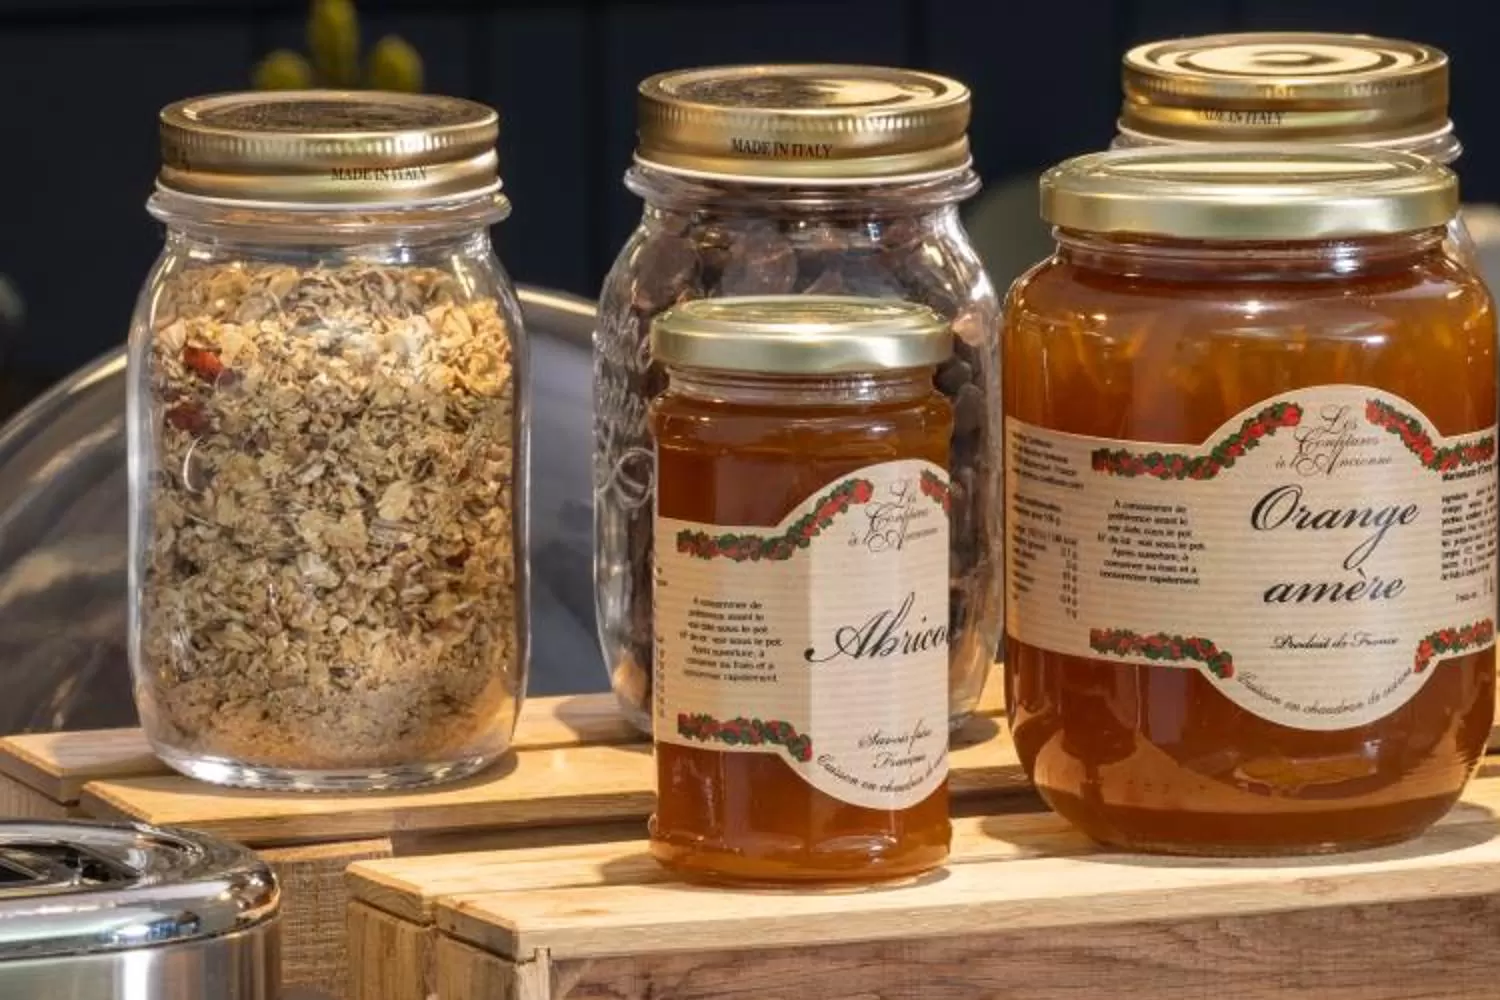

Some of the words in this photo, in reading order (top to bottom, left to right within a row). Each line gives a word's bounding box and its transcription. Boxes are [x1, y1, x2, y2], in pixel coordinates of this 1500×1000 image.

[731, 137, 771, 156] MADE
[774, 141, 789, 157] IN
[792, 143, 833, 158] ITALY
[332, 167, 372, 181] MADE
[375, 167, 390, 181] IN
[1251, 484, 1420, 571] Orange
[1263, 567, 1406, 603] amère
[1270, 632, 1331, 650] Produit
[1331, 631, 1348, 649] de
[1350, 631, 1399, 649] France
[1284, 701, 1300, 712] en
[861, 781, 877, 792] en
